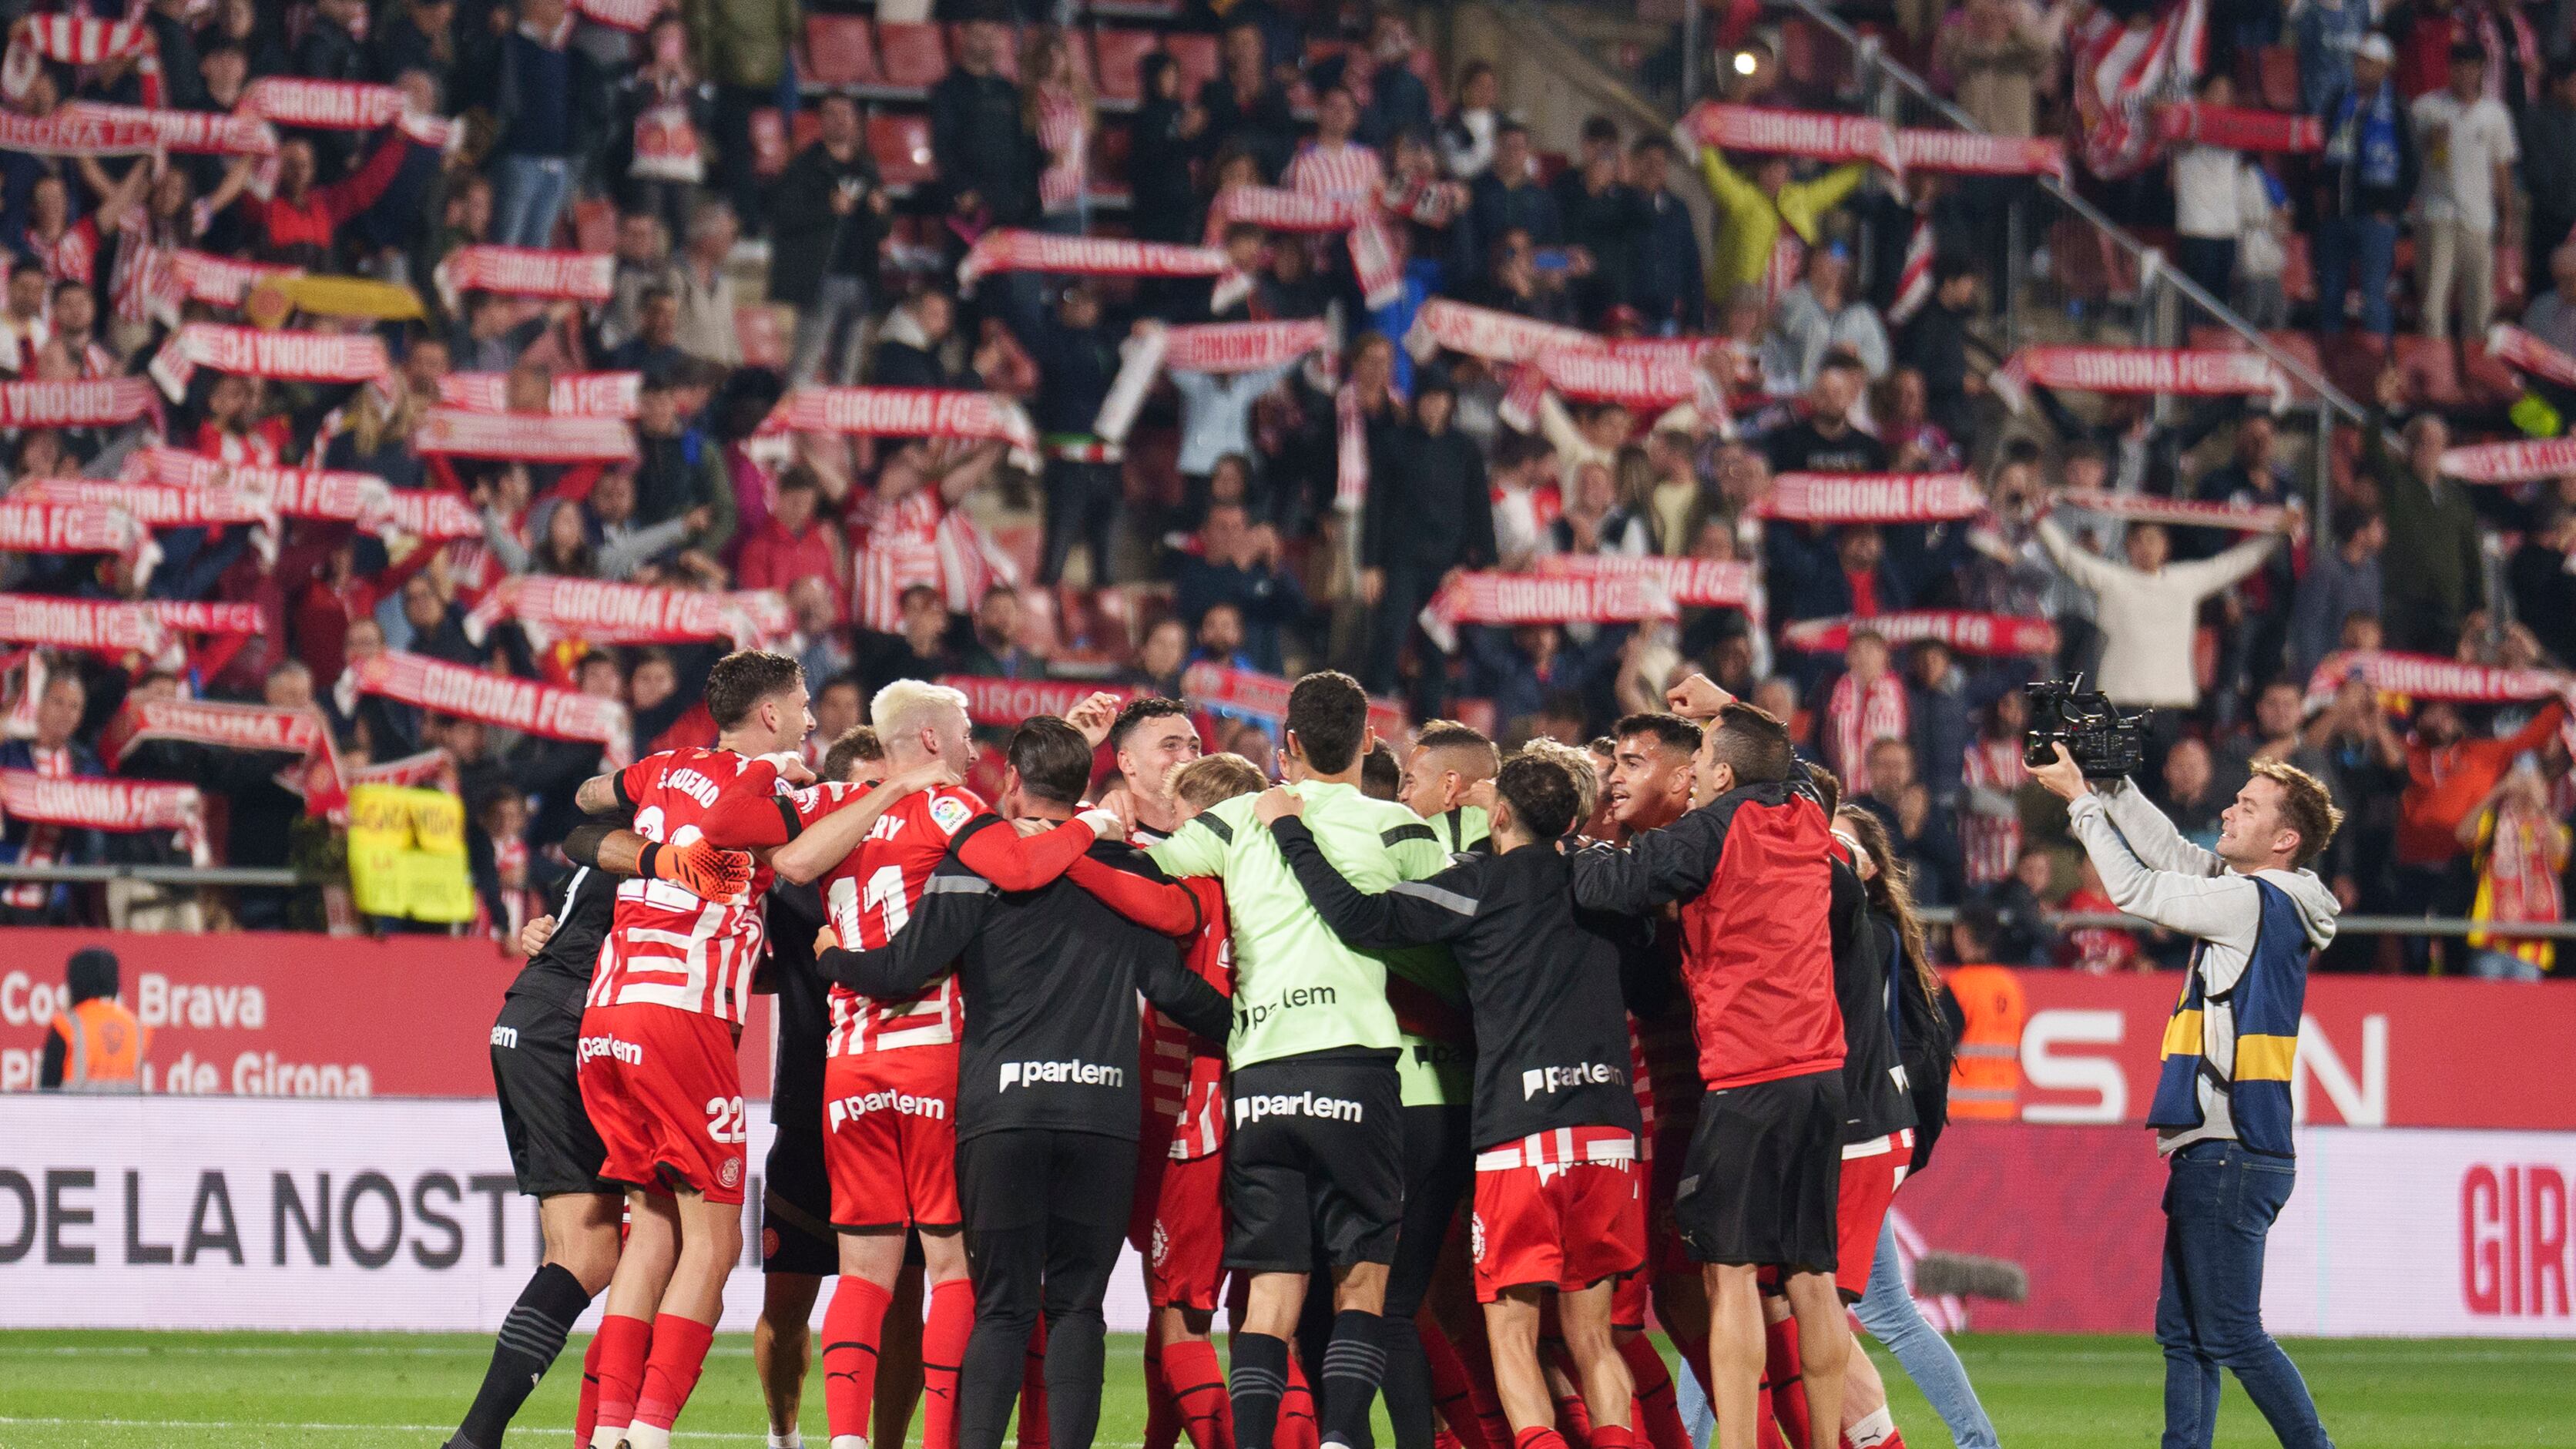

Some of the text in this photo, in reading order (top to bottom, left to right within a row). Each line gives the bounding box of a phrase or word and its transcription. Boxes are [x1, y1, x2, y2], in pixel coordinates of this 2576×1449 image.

[1557, 354, 1645, 393] GIRONA
[2074, 352, 2175, 386] GIRONA
[823, 394, 971, 429] GIRONA FC
[303, 471, 339, 515] FC
[1807, 478, 1944, 518] GIRONA FC
[49, 505, 84, 549] FC
[552, 582, 662, 632] GIRONA
[1496, 578, 1622, 619] GIRONA FC
[422, 664, 578, 730] GIRONA FC
[964, 683, 1088, 719] IRON
[666, 767, 719, 810] BUENO
[827, 864, 910, 953] 11
[139, 972, 265, 1028] Brava
[579, 1032, 642, 1065] parlem
[166, 1051, 220, 1095] de
[233, 1052, 371, 1097] Girona
[1021, 1058, 1124, 1088] parlem
[1545, 1062, 1626, 1094] parlem
[706, 1096, 746, 1144] 22
[845, 1088, 945, 1122] parlem
[1251, 1091, 1363, 1124] parlem
[124, 1169, 244, 1266] LA
[271, 1170, 544, 1270] NOST
[2462, 1163, 2576, 1317] GIR
